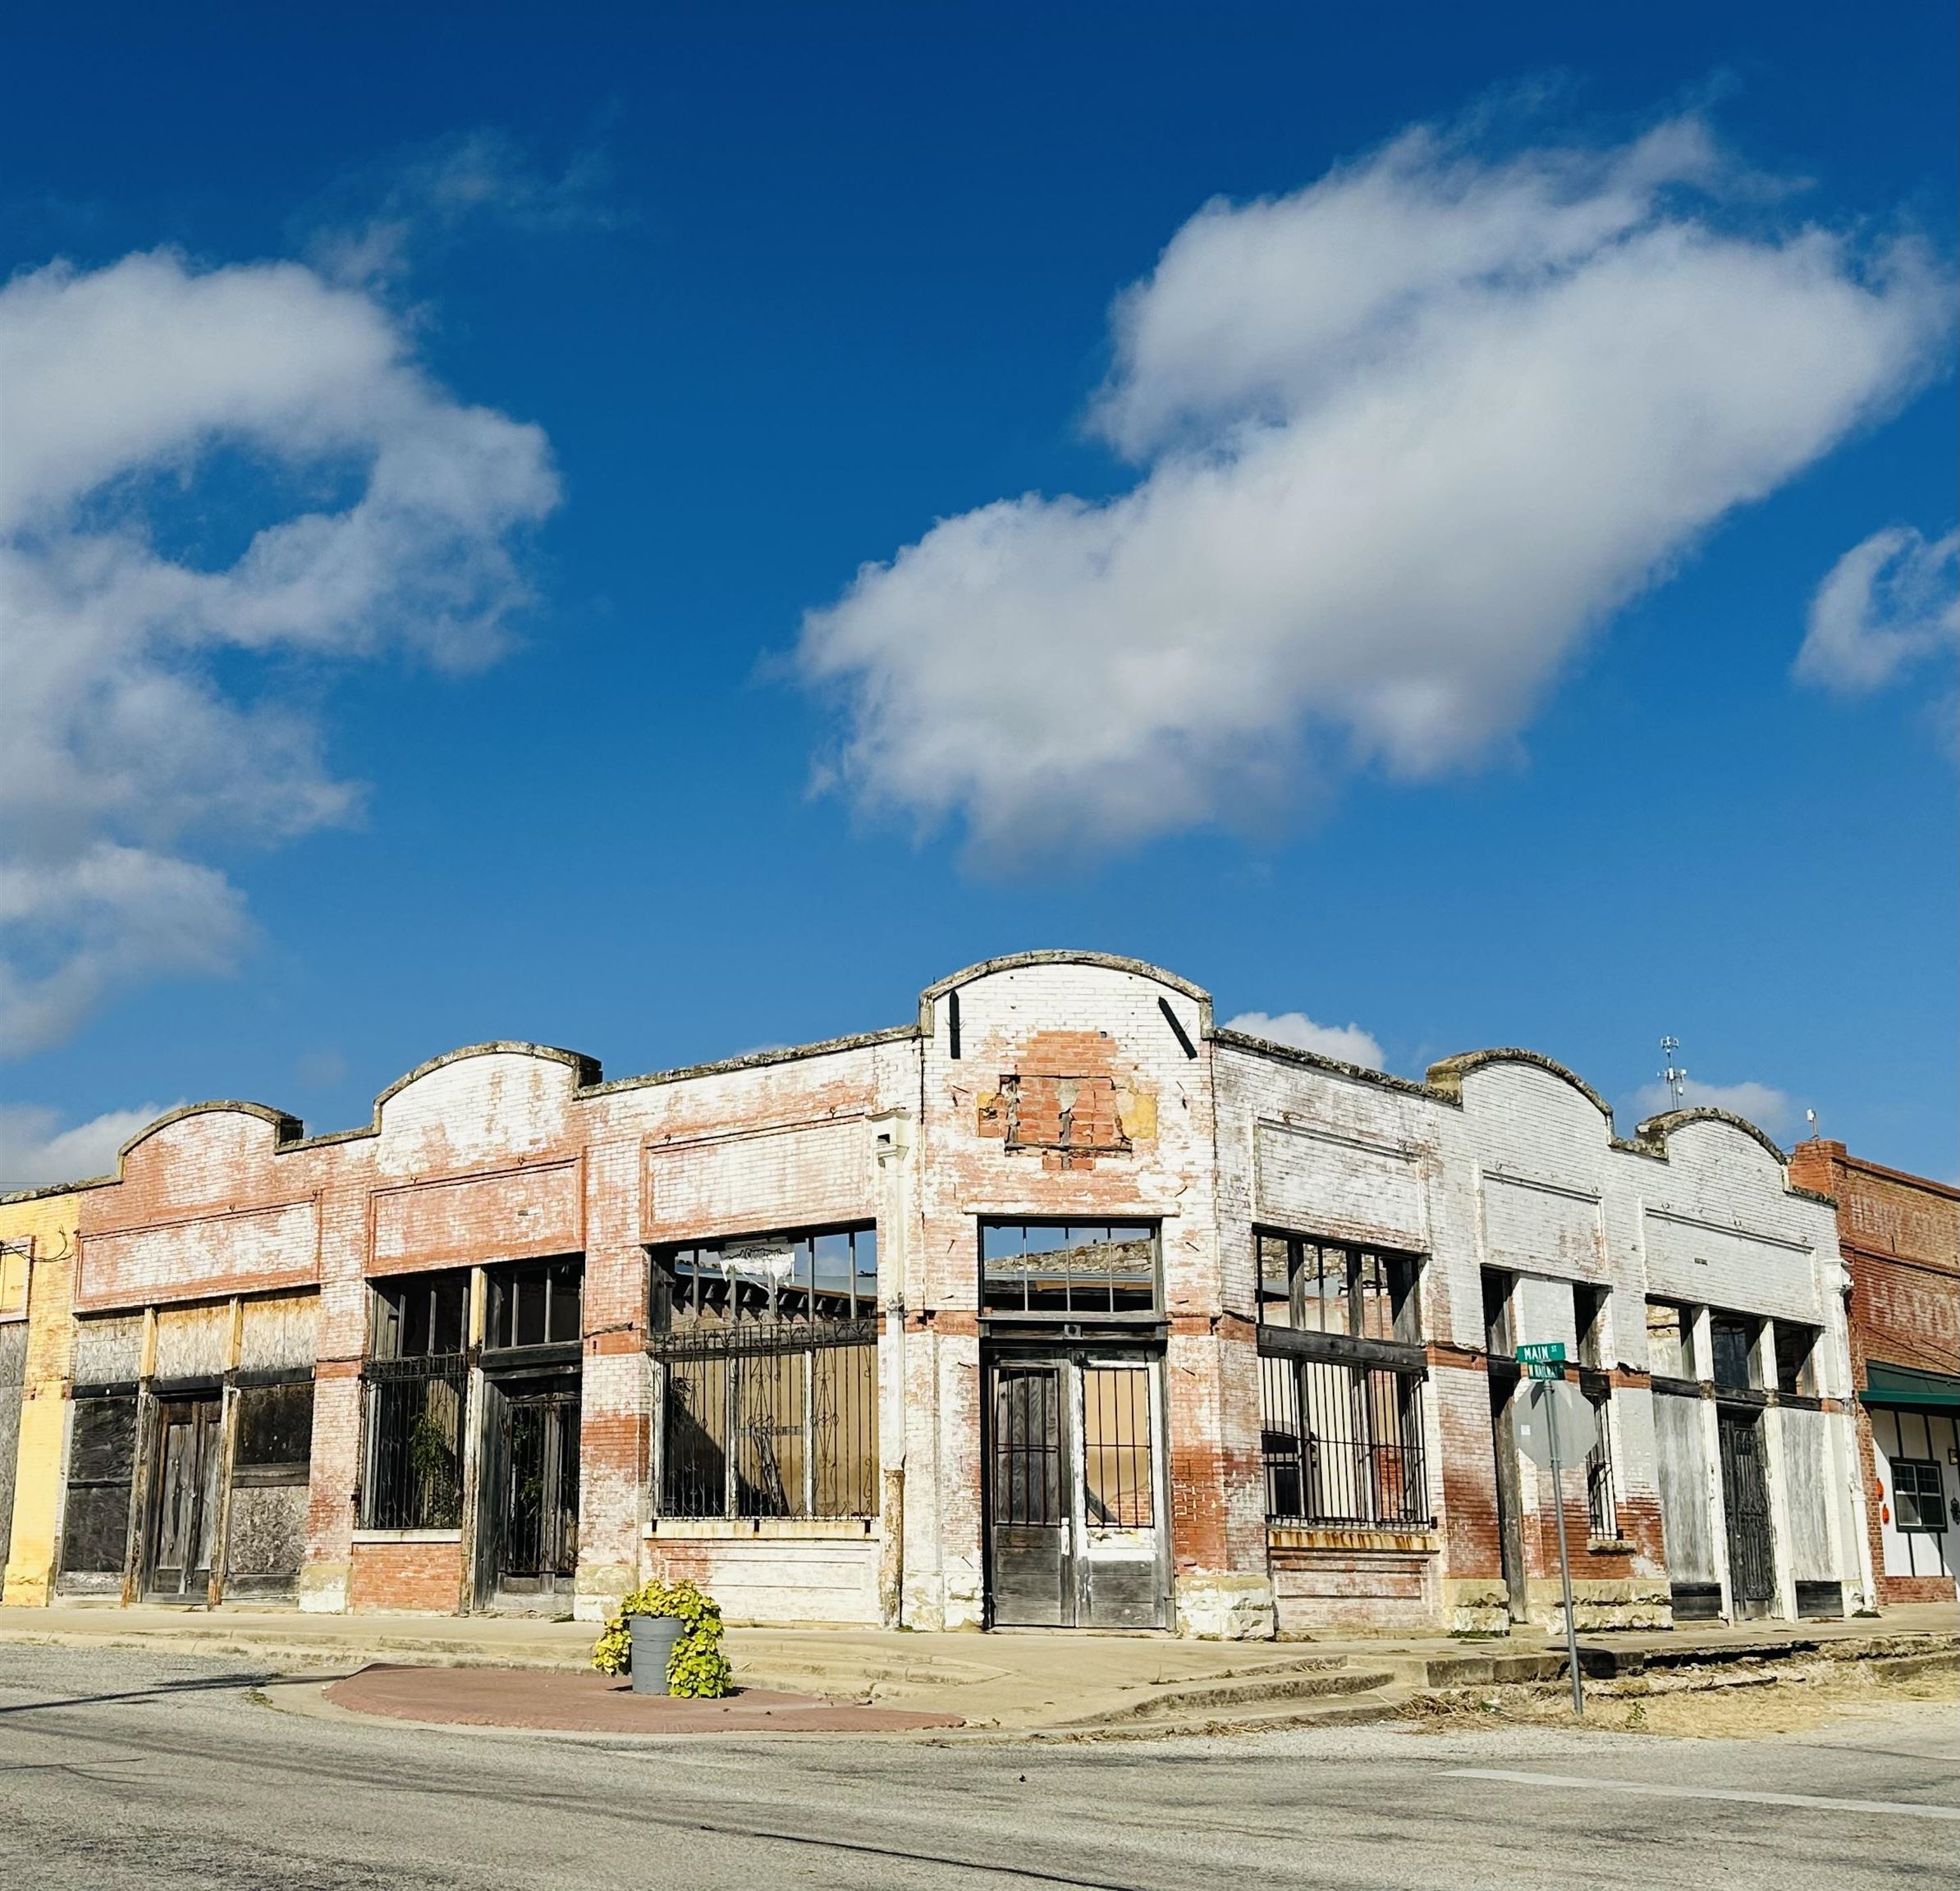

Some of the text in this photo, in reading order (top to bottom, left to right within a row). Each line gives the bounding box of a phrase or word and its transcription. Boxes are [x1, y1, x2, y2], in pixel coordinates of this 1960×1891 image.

[1866, 1277, 1960, 1338] HARD
[1523, 1344, 1557, 1360] MAIN ST
